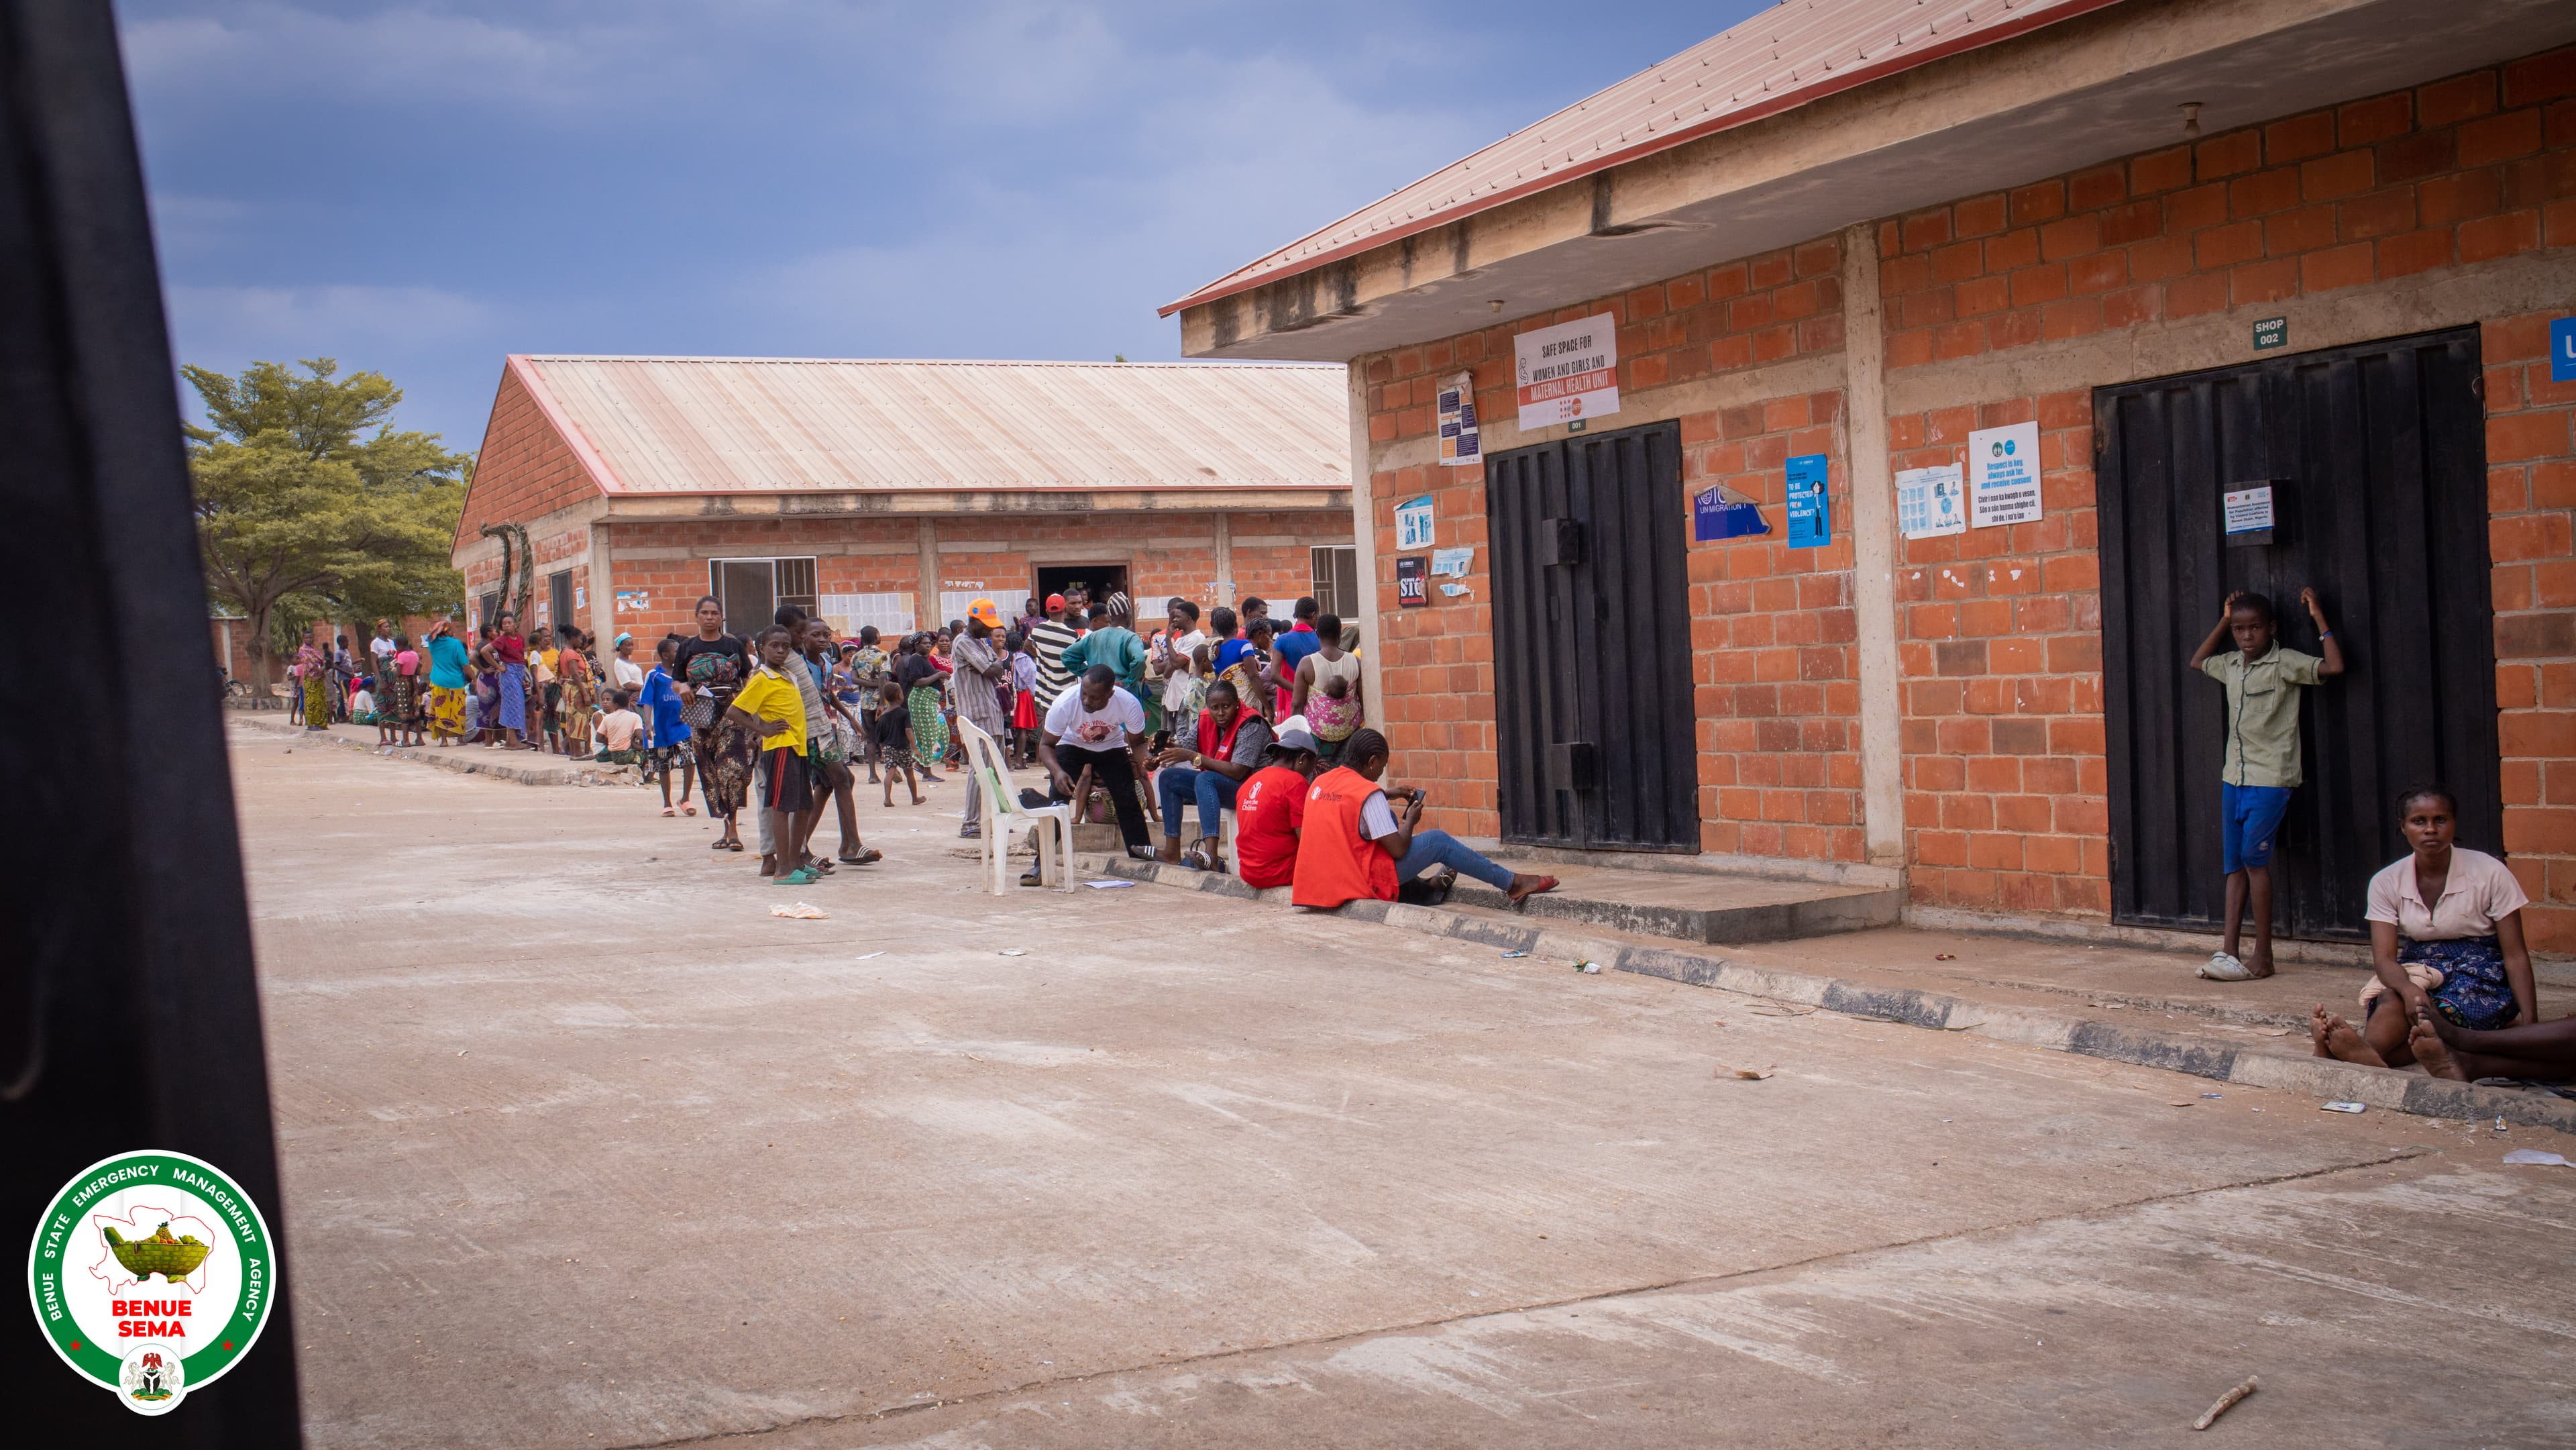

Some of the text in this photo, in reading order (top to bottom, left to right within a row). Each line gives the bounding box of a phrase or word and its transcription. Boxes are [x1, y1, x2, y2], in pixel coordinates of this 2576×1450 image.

[2255, 319, 2284, 333] SHOP
[2261, 333, 2279, 345] 002
[1542, 335, 1592, 358] SAFE SPACE FOR
[1533, 355, 1605, 382] WOMEN AND GIRLS AND
[1531, 370, 1608, 401] MATERNAL HEALTH UNIT
[1987, 461, 2007, 470] Respect
[1988, 472, 2005, 480] always
[1981, 476, 2031, 490] and receive consent
[1788, 490, 1813, 500] PROTECTED
[1700, 503, 1741, 514] UN MIGRATION
[1790, 509, 1815, 517] VIOLENCE?
[663, 694, 680, 702] Unic
